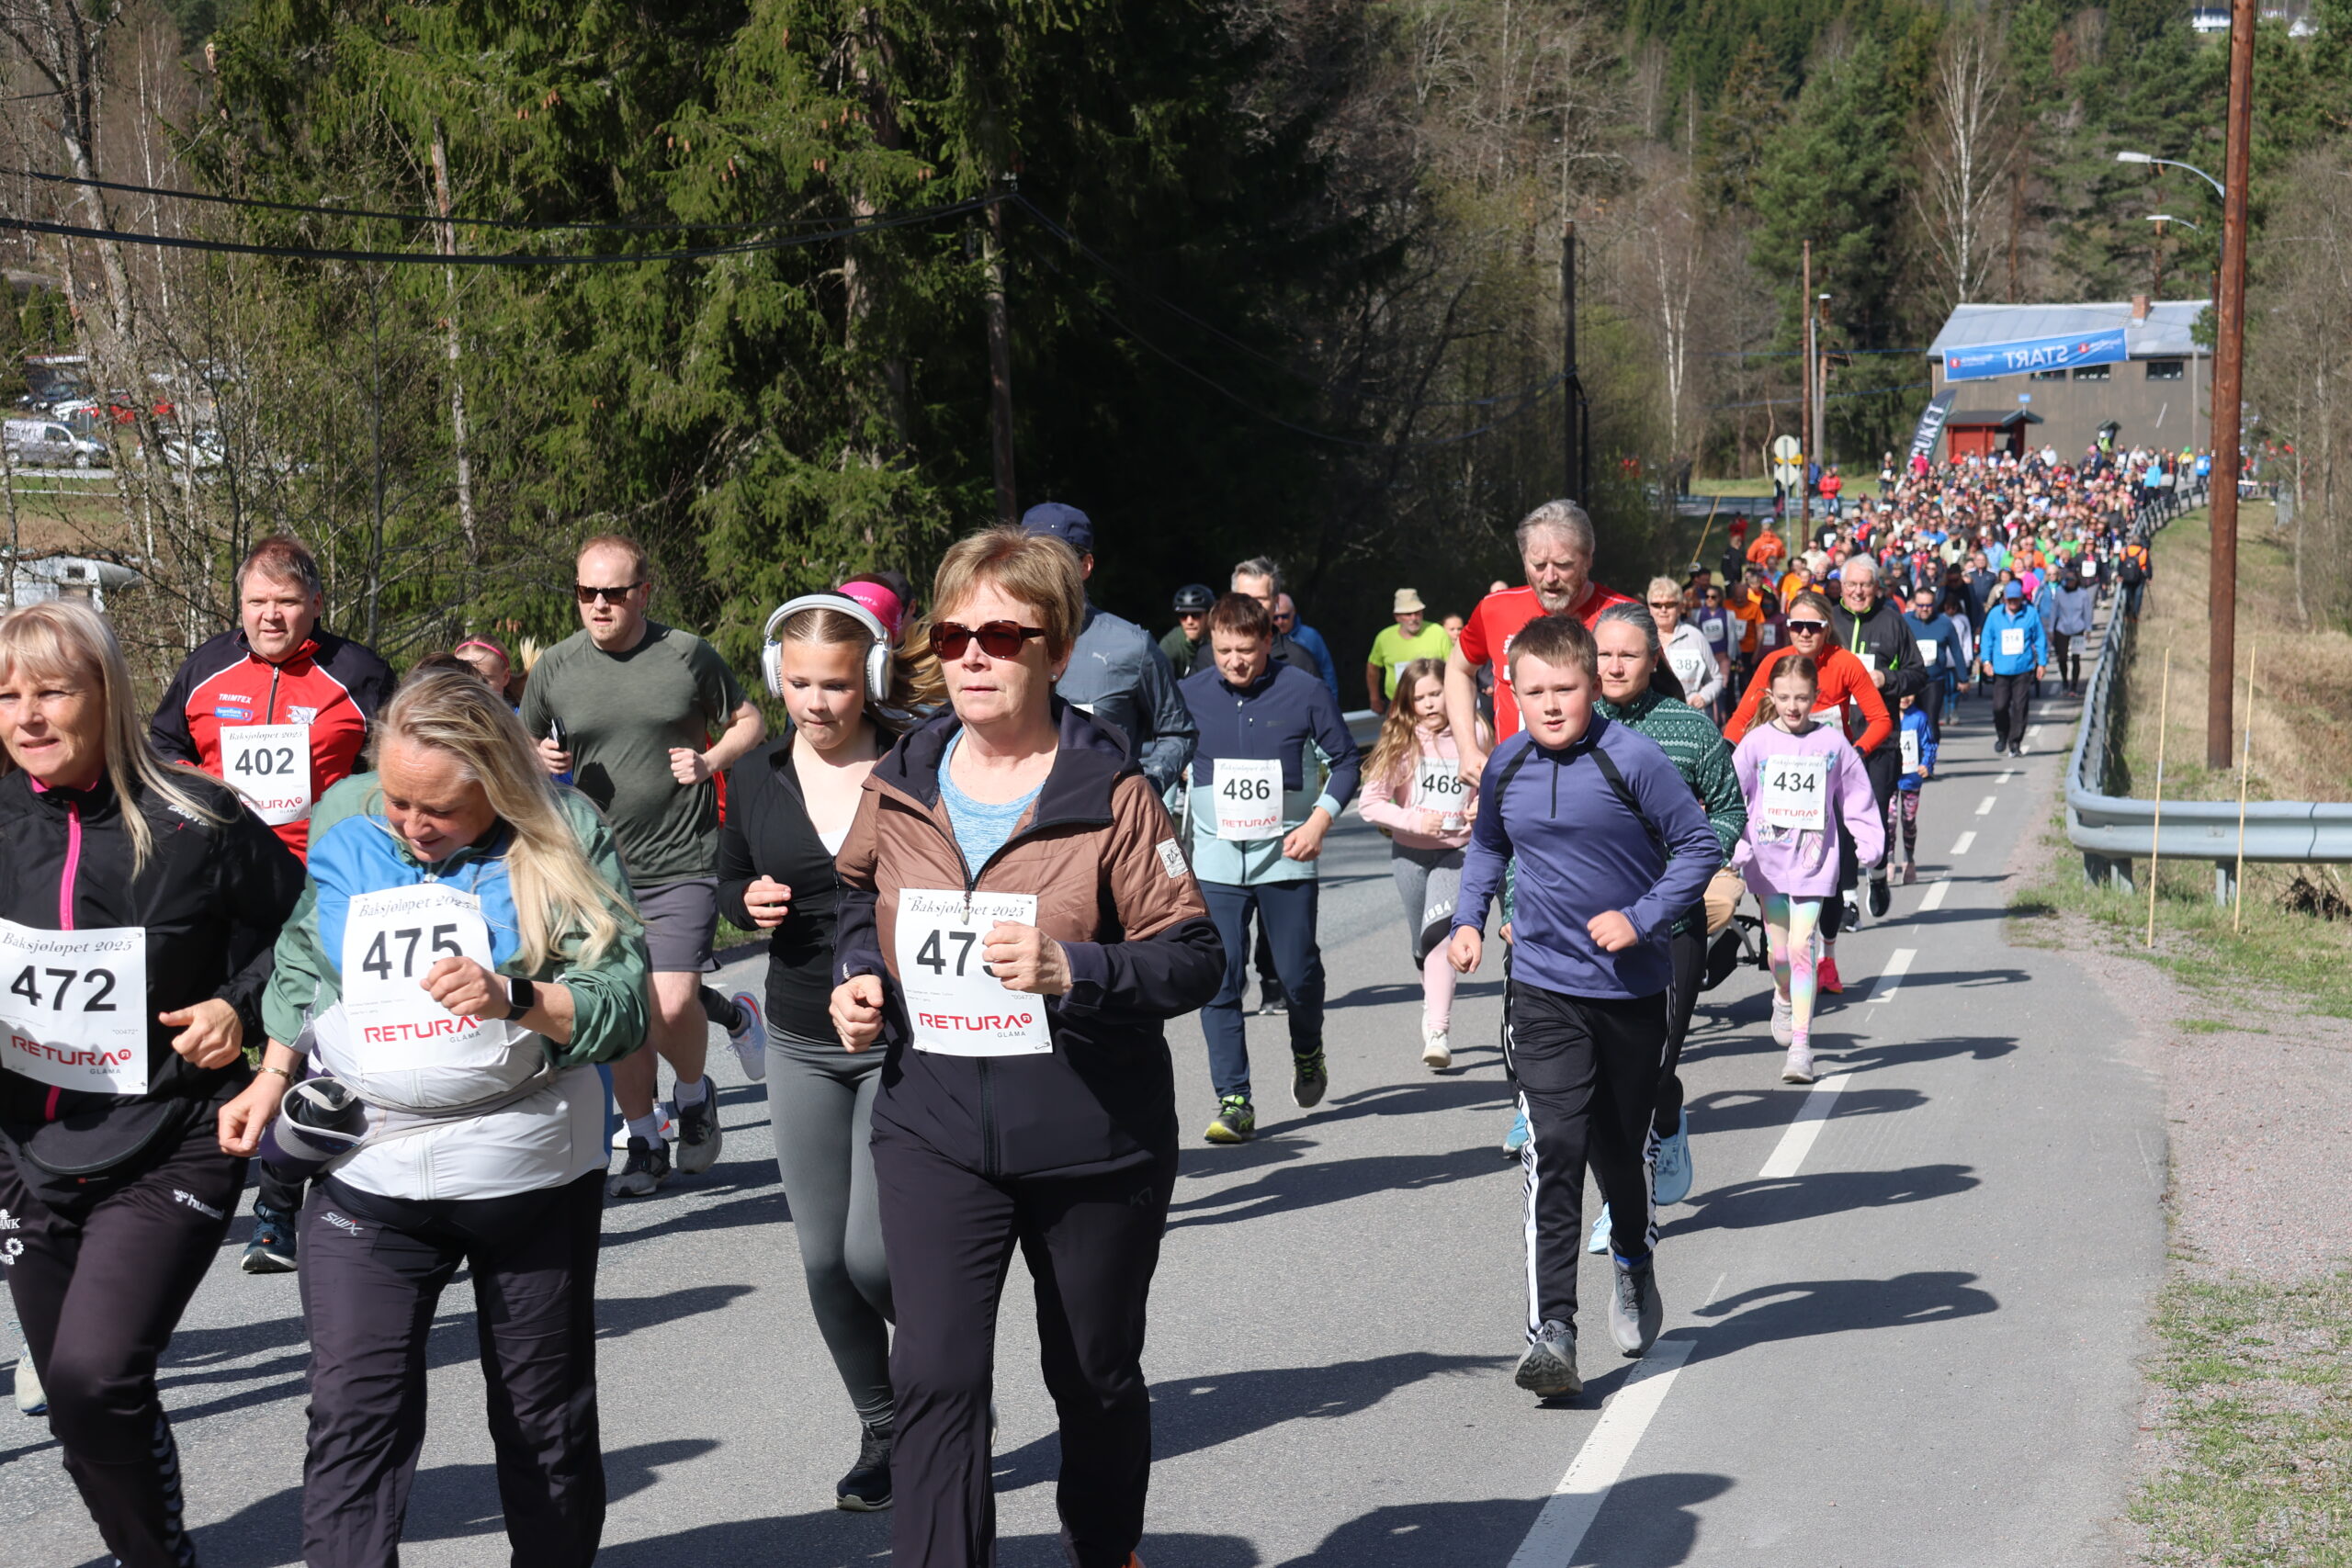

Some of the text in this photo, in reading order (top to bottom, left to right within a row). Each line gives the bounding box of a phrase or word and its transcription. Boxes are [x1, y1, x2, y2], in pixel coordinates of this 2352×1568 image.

[218, 694, 253, 704] TRIMTEX
[234, 747, 294, 776] 402
[1223, 778, 1270, 800] 486
[1421, 773, 1462, 795] 468
[1773, 772, 1815, 793] 434
[1222, 818, 1272, 828] RETURA
[1768, 807, 1814, 817] RETURA
[358, 897, 431, 918] Baksjøløpet
[991, 907, 1025, 917] 2025
[2, 931, 133, 957] Baksjøløpet 2025
[362, 923, 463, 980] 475
[916, 929, 999, 977] 47
[10, 964, 117, 1012] 472
[364, 1015, 478, 1043] RETURA
[919, 1012, 1023, 1031] RETURA
[11, 1034, 119, 1066] RETURA
